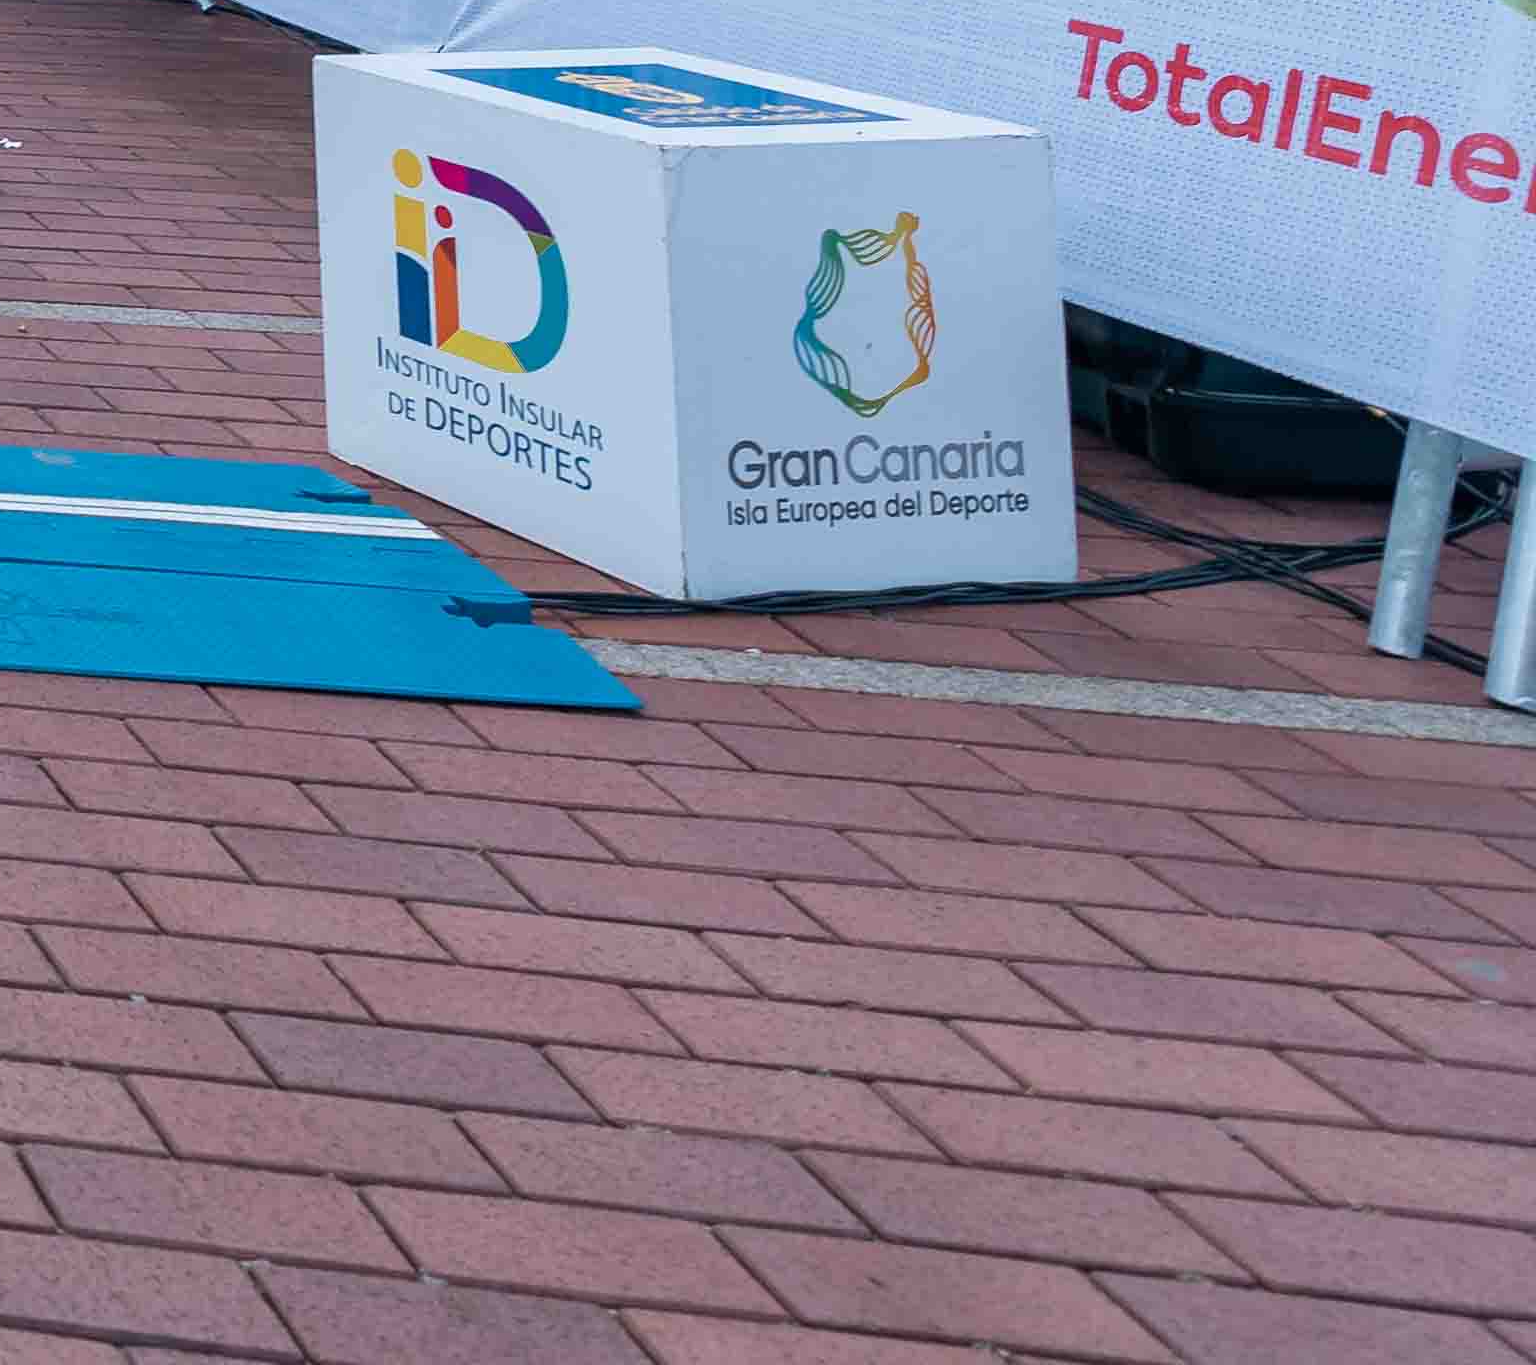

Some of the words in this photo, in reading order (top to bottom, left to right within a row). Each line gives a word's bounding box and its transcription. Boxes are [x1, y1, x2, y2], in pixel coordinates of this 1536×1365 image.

[377, 336, 490, 406] INSTITUTO
[500, 382, 603, 451] INSULAR
[388, 391, 416, 422] DE
[426, 397, 592, 491] DEPORTES
[727, 439, 839, 492] Gran
[844, 430, 1025, 484] Canaria
[727, 498, 770, 528] Isla
[777, 498, 876, 530] Europea
[883, 492, 923, 520] del
[929, 486, 1031, 522] Deporte
